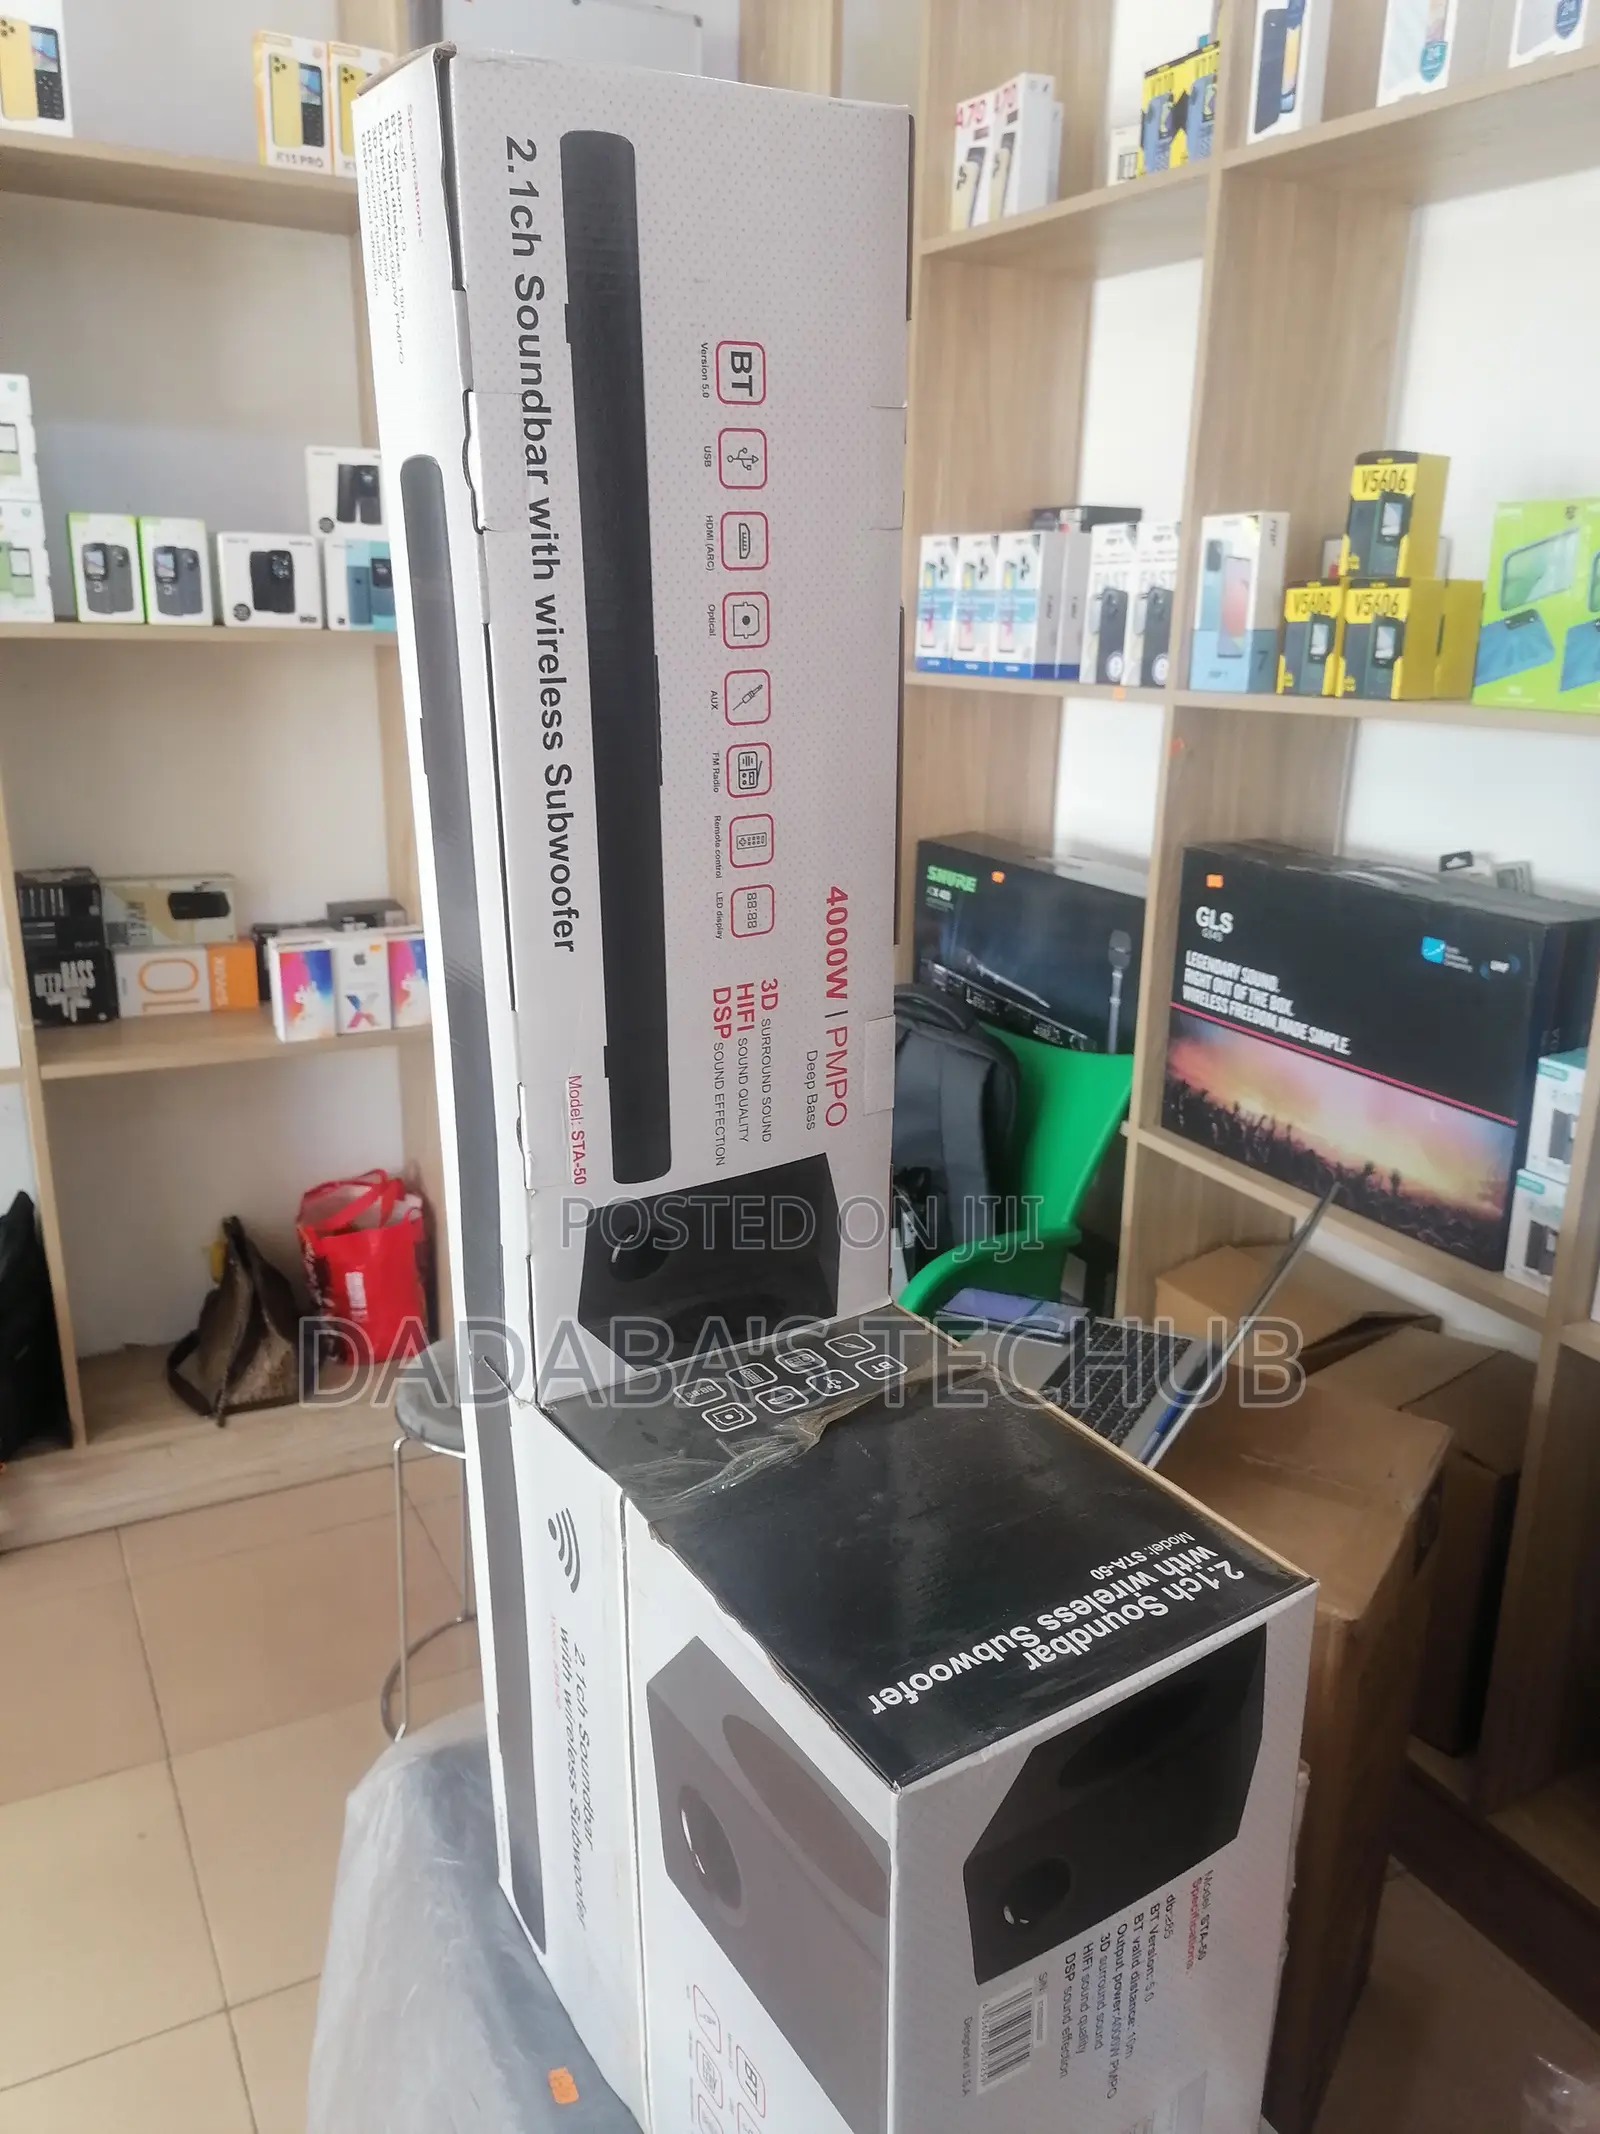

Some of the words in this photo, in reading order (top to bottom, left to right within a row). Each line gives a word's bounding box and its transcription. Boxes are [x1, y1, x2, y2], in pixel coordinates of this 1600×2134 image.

[507, 136, 542, 257] 2.1ch
[514, 274, 552, 485] Soundbar
[700, 342, 710, 380] Version
[731, 351, 753, 397] BT
[702, 381, 710, 398] 5.0
[704, 445, 712, 467] USB
[1362, 470, 1408, 493] V5606
[528, 497, 561, 580] with
[705, 515, 713, 541] HDMI
[706, 543, 714, 572] (ARC)
[708, 604, 716, 637] Optical
[1293, 593, 1332, 614] V5606
[1355, 593, 1400, 616] V5606
[535, 594, 567, 751] wireless
[710, 690, 718, 710] AUX
[712, 752, 720, 766] FM
[712, 768, 720, 793] Radio
[714, 815, 722, 847] Remote
[545, 764, 579, 952] Subwoofer
[1195, 906, 1234, 934] GLS
[825, 886, 849, 999] 4000W
[1186, 950, 1242, 981] LEGENDARY
[736, 983, 755, 1032] HIFI
[760, 978, 778, 1011] 3D
[1183, 984, 1230, 1015] WIRELESS
[1184, 967, 1213, 991] RIGHT
[1212, 977, 1233, 997] OUT
[1233, 983, 1249, 1002] OF
[1248, 988, 1270, 1009] THE
[713, 986, 732, 1039] DSP
[714, 1042, 725, 1090] SOUND
[737, 1037, 748, 1085] SOUND
[761, 1018, 772, 1093] SURROUND
[804, 1050, 818, 1090] Deep
[825, 1026, 848, 1127] PMPO
[568, 1075, 584, 1126] Model:
[738, 1087, 749, 1143] QUALITY
[761, 1096, 772, 1143] SOUND
[805, 1093, 818, 1130] Bass
[714, 1093, 726, 1167] EFFECTION
[571, 1130, 586, 1185] STA-50
[1145, 1531, 1196, 1557] Model:
[1153, 1545, 1219, 1577] with
[1090, 1551, 1147, 1580] STA-50
[1161, 1559, 1244, 1603] 2.1ch
[1037, 1571, 1160, 1631] wireless
[1023, 1595, 1170, 1671] Soundbar
[559, 1626, 572, 1685] with
[867, 1624, 1041, 1715] Subwoofer
[574, 1641, 587, 1722] 2.1ch
[563, 1688, 577, 1797] wireless
[577, 1724, 595, 1852] Soundbar
[570, 1799, 587, 1931] Subwoofer
[1133, 1913, 1144, 1937] BT
[1149, 1903, 1160, 1927] BT
[1100, 1932, 1111, 1952] 3D
[1116, 1923, 1128, 1969] Output
[1132, 1941, 1142, 1968] valid
[1146, 1929, 1159, 1981] Version:
[1064, 1952, 1076, 1982] DSP
[1097, 1955, 1108, 2010] surround
[1061, 1985, 1073, 2024] sound
[1079, 1974, 1090, 2012] sound
[1127, 1970, 1141, 2029] distance:
[1075, 2014, 1088, 2055] quality
[1094, 2012, 1106, 2050] sound
[744, 2060, 758, 2105] BT
[1107, 2058, 1119, 2099] PMPO
